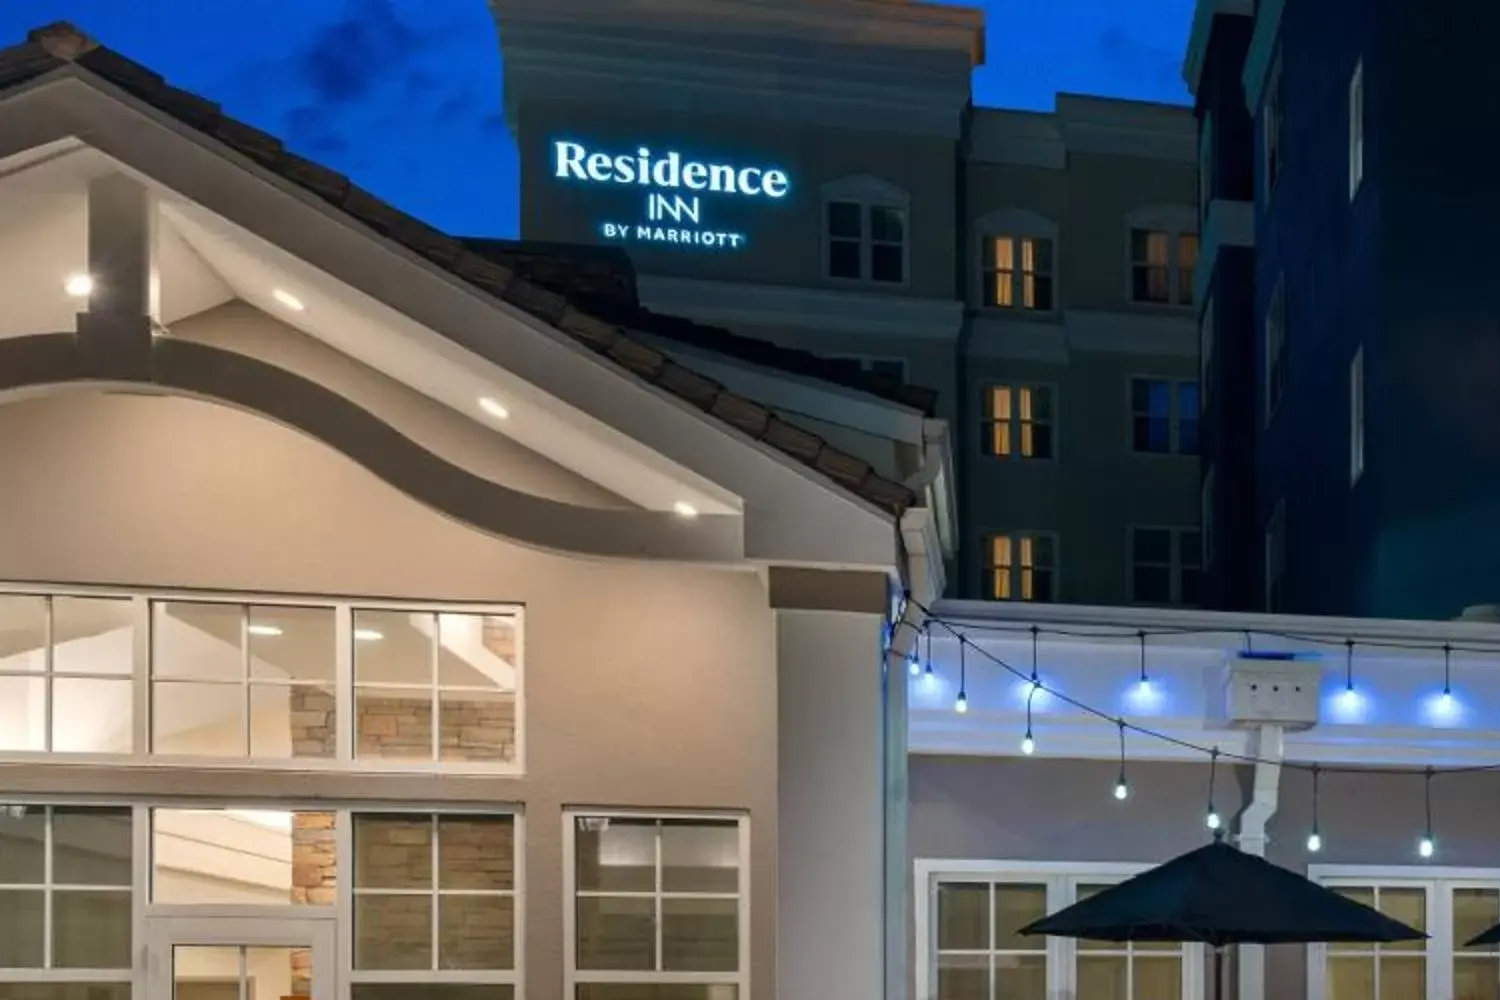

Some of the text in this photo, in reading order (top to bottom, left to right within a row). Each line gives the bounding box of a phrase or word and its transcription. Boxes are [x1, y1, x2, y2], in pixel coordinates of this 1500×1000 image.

[554, 141, 788, 197] Residence
[649, 193, 699, 223] INN
[604, 224, 740, 247] BY MARRIOTT
